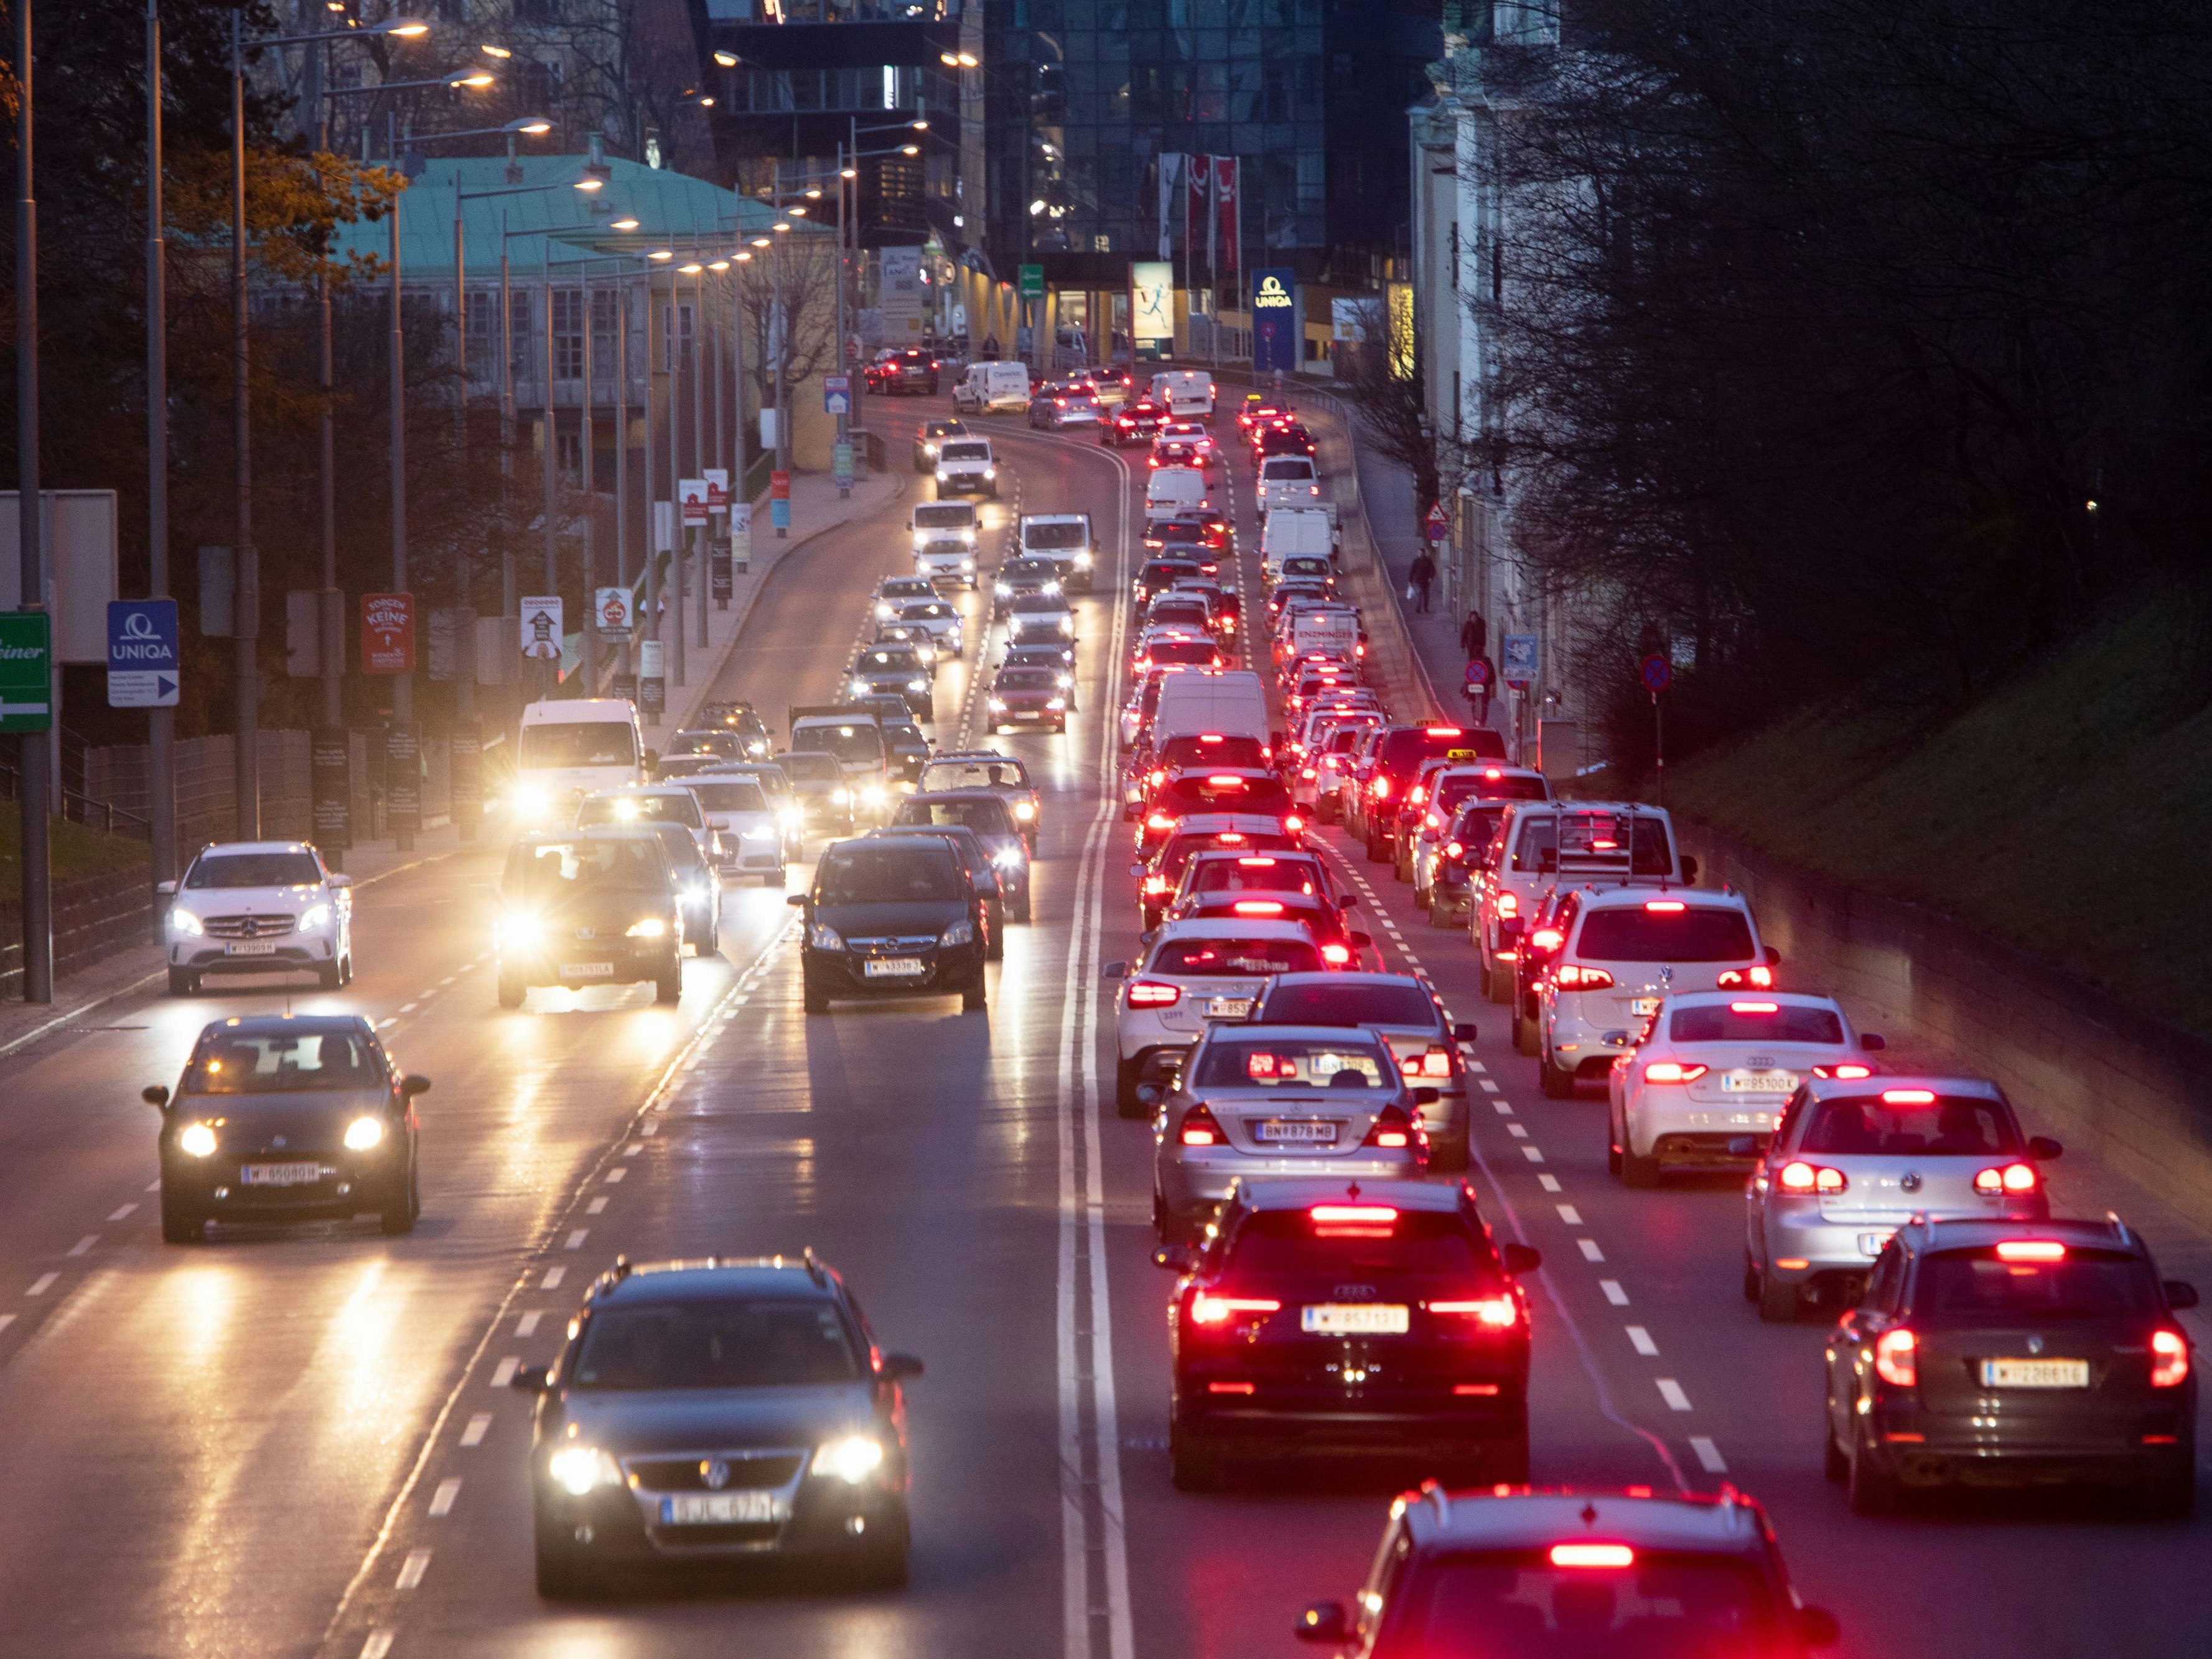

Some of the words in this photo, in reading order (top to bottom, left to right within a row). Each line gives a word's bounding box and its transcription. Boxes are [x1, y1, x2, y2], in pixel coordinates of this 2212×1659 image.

[1255, 295, 1292, 307] UNIQA
[365, 610, 409, 626] KEINE
[113, 644, 172, 659] UNIQA
